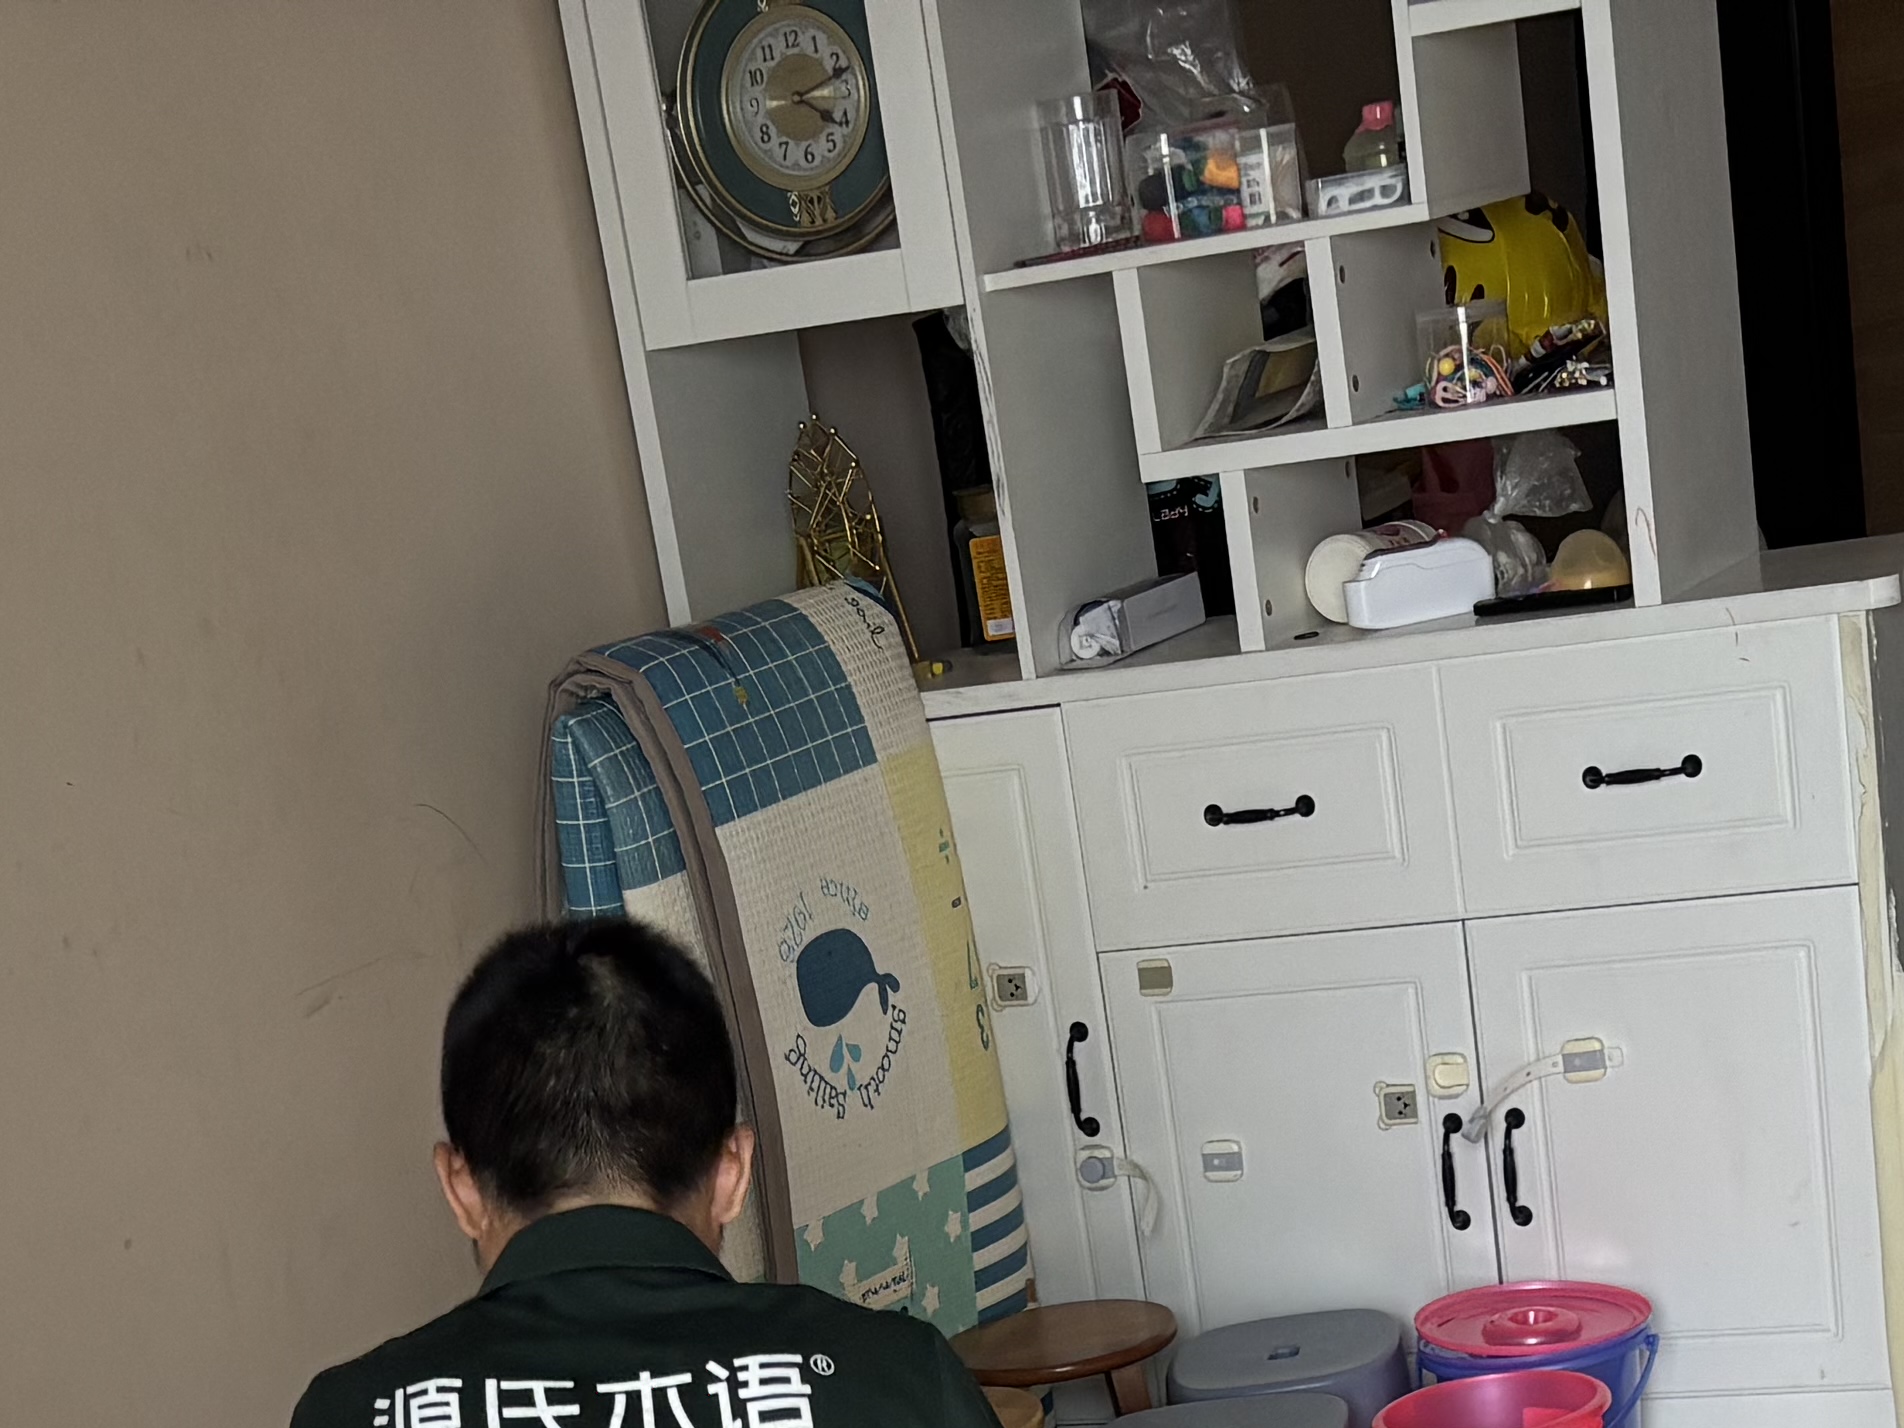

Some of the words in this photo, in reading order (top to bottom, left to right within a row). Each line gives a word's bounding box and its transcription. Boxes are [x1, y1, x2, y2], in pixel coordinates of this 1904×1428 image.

[783, 29, 800, 49] 12
[811, 35, 819, 54] 1
[761, 43, 775, 63] 11
[830, 52, 840, 72] 2
[748, 67, 764, 87] 10
[841, 79, 851, 98] 3
[749, 97, 760, 118] 9
[838, 108, 849, 128] 4
[759, 123, 771, 144] 8
[826, 132, 837, 153] 5
[778, 141, 789, 161] 7
[804, 143, 815, 164] 6
